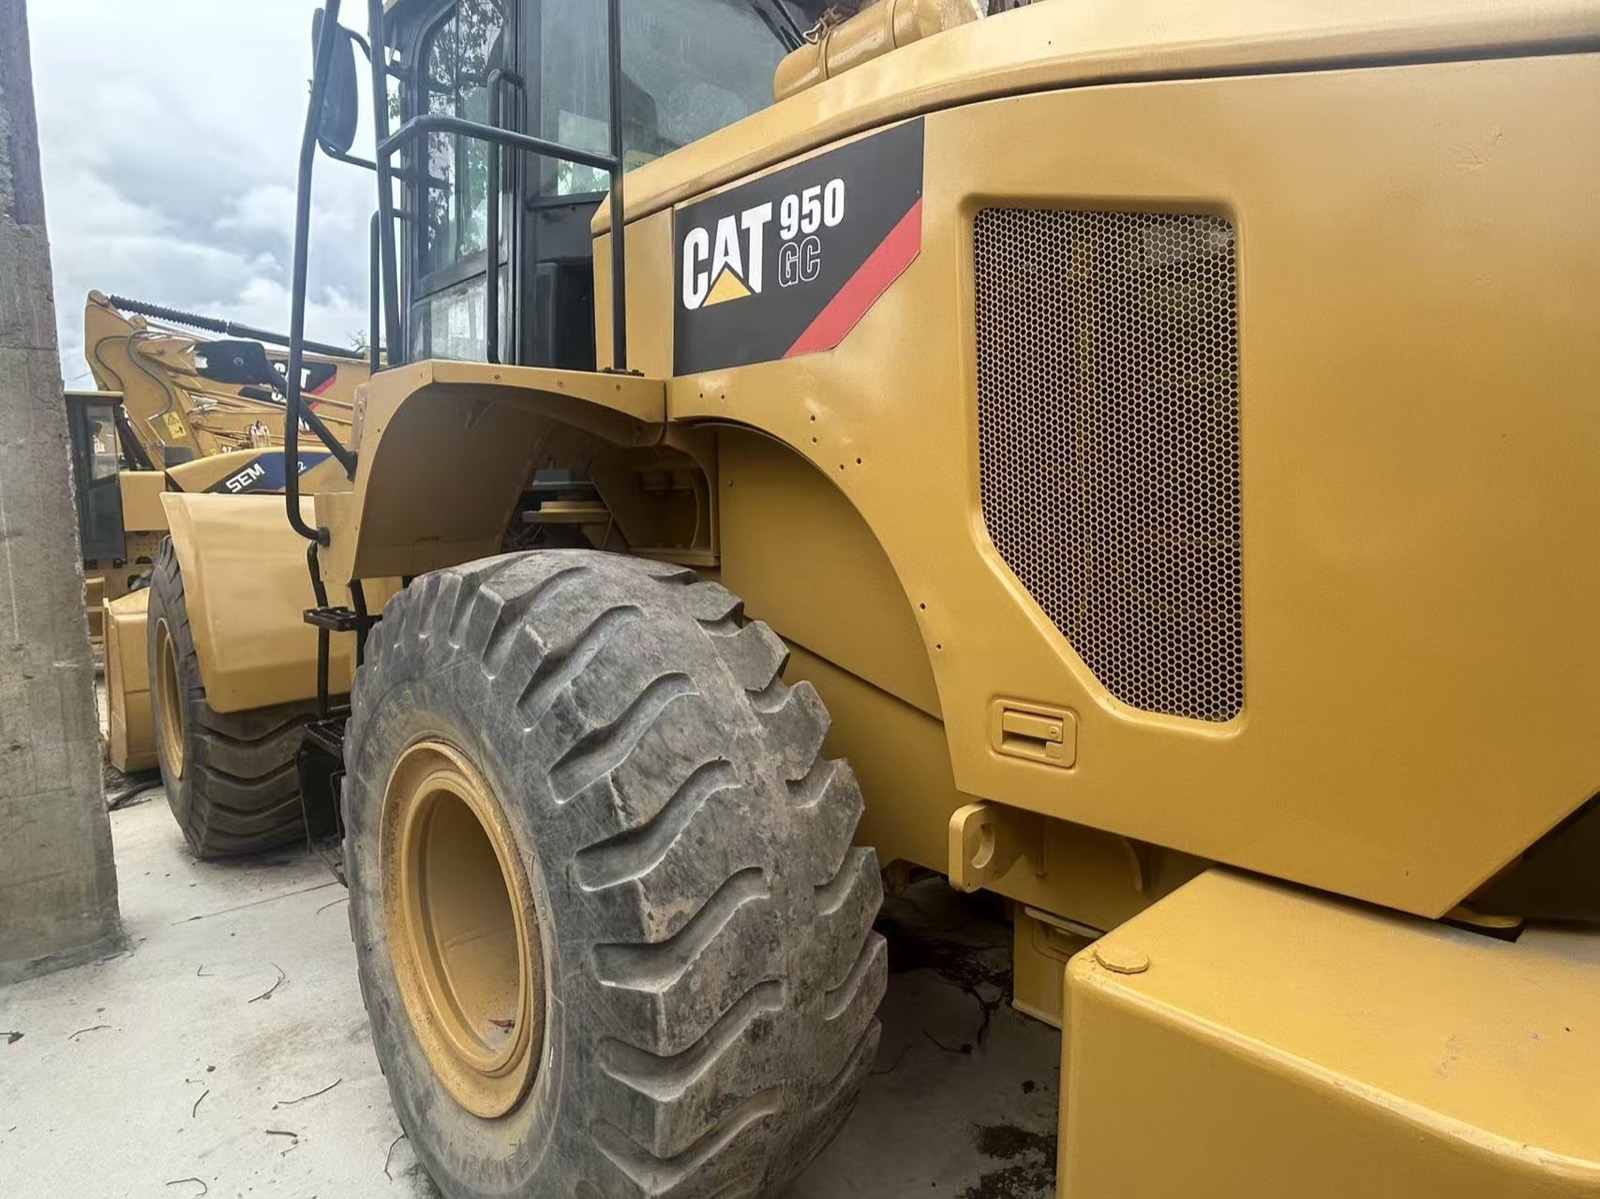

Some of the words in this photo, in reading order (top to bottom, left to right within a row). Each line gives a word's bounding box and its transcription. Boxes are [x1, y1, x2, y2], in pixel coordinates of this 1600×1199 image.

[683, 202, 772, 310] CAT
[780, 178, 845, 240] 950
[778, 235, 821, 287] GC
[225, 463, 265, 493] SEM
